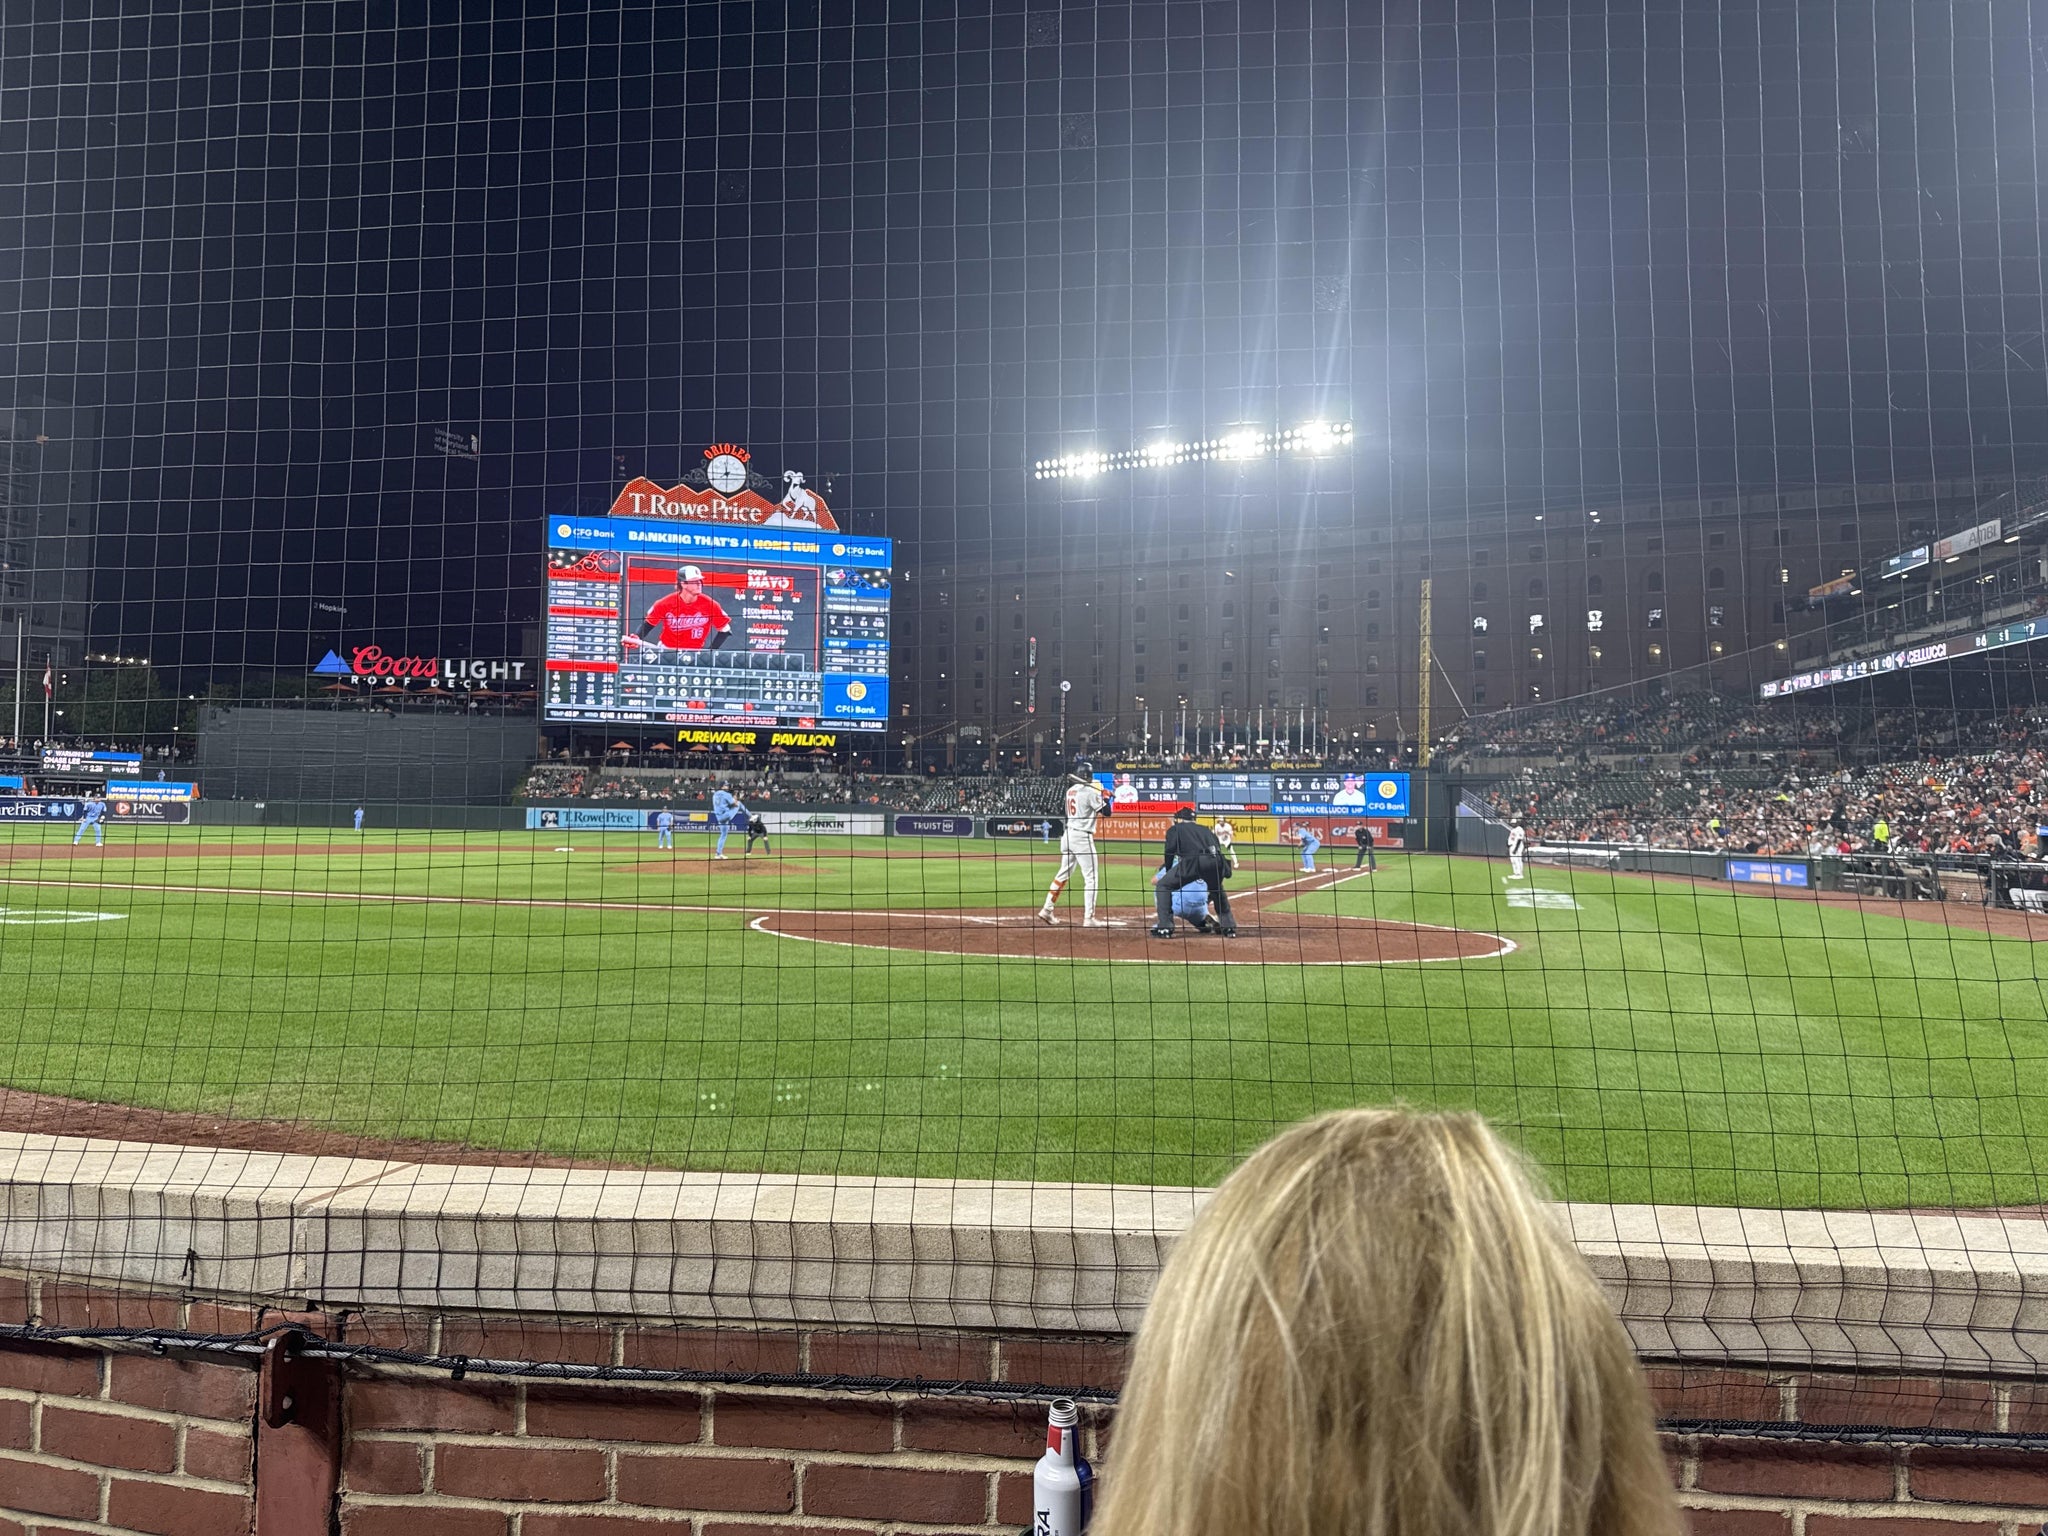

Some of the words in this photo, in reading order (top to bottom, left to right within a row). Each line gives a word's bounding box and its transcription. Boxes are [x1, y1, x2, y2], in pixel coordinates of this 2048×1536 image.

[703, 442, 752, 463] ORIOLES
[713, 498, 762, 523] Price
[573, 528, 592, 537] CFG
[594, 529, 615, 538] Bank
[628, 531, 692, 545] BANKING
[693, 535, 739, 548] THAT'S
[741, 539, 751, 548] A
[753, 539, 791, 551] HOME
[847, 545, 865, 555] CFG
[865, 548, 885, 557] Bank
[747, 575, 790, 589] MAYO
[319, 602, 348, 614] Hopkins
[1907, 642, 1947, 664] CELLUCCI
[352, 645, 439, 679] Coors
[444, 659, 525, 681] LIGHT
[351, 675, 411, 685] ROOF
[430, 678, 488, 689] DECK
[657, 675, 665, 684] 0
[668, 676, 676, 684] 0
[680, 676, 688, 685] 0
[693, 676, 701, 685] 0
[704, 677, 711, 686] 0
[715, 677, 723, 686] 0
[657, 687, 664, 696] 3
[668, 687, 676, 697] 0
[680, 688, 688, 697] 0
[693, 689, 699, 697] 1
[703, 689, 711, 698] 0
[764, 691, 772, 700] 4
[786, 692, 794, 701] 0
[800, 693, 808, 702] 4
[835, 705, 854, 713] CFG
[855, 705, 876, 714] Bank
[677, 730, 757, 745] PUREWAGER
[770, 733, 837, 747] PAVILION
[43, 756, 67, 764] CHASE
[55, 750, 85, 758] WARMING
[138, 787, 166, 795] ACCOUNT
[132, 802, 163, 815] PNC
[1283, 806, 1316, 814] BRENDAN
[1315, 806, 1349, 814] CELLUCCI
[1368, 802, 1385, 810] CFG
[1386, 802, 1406, 811] Bank
[606, 811, 633, 824] Price
[912, 821, 941, 831] TRUIST
[1099, 820, 1139, 829] AUTUMN
[1142, 821, 1166, 829] LAKE
